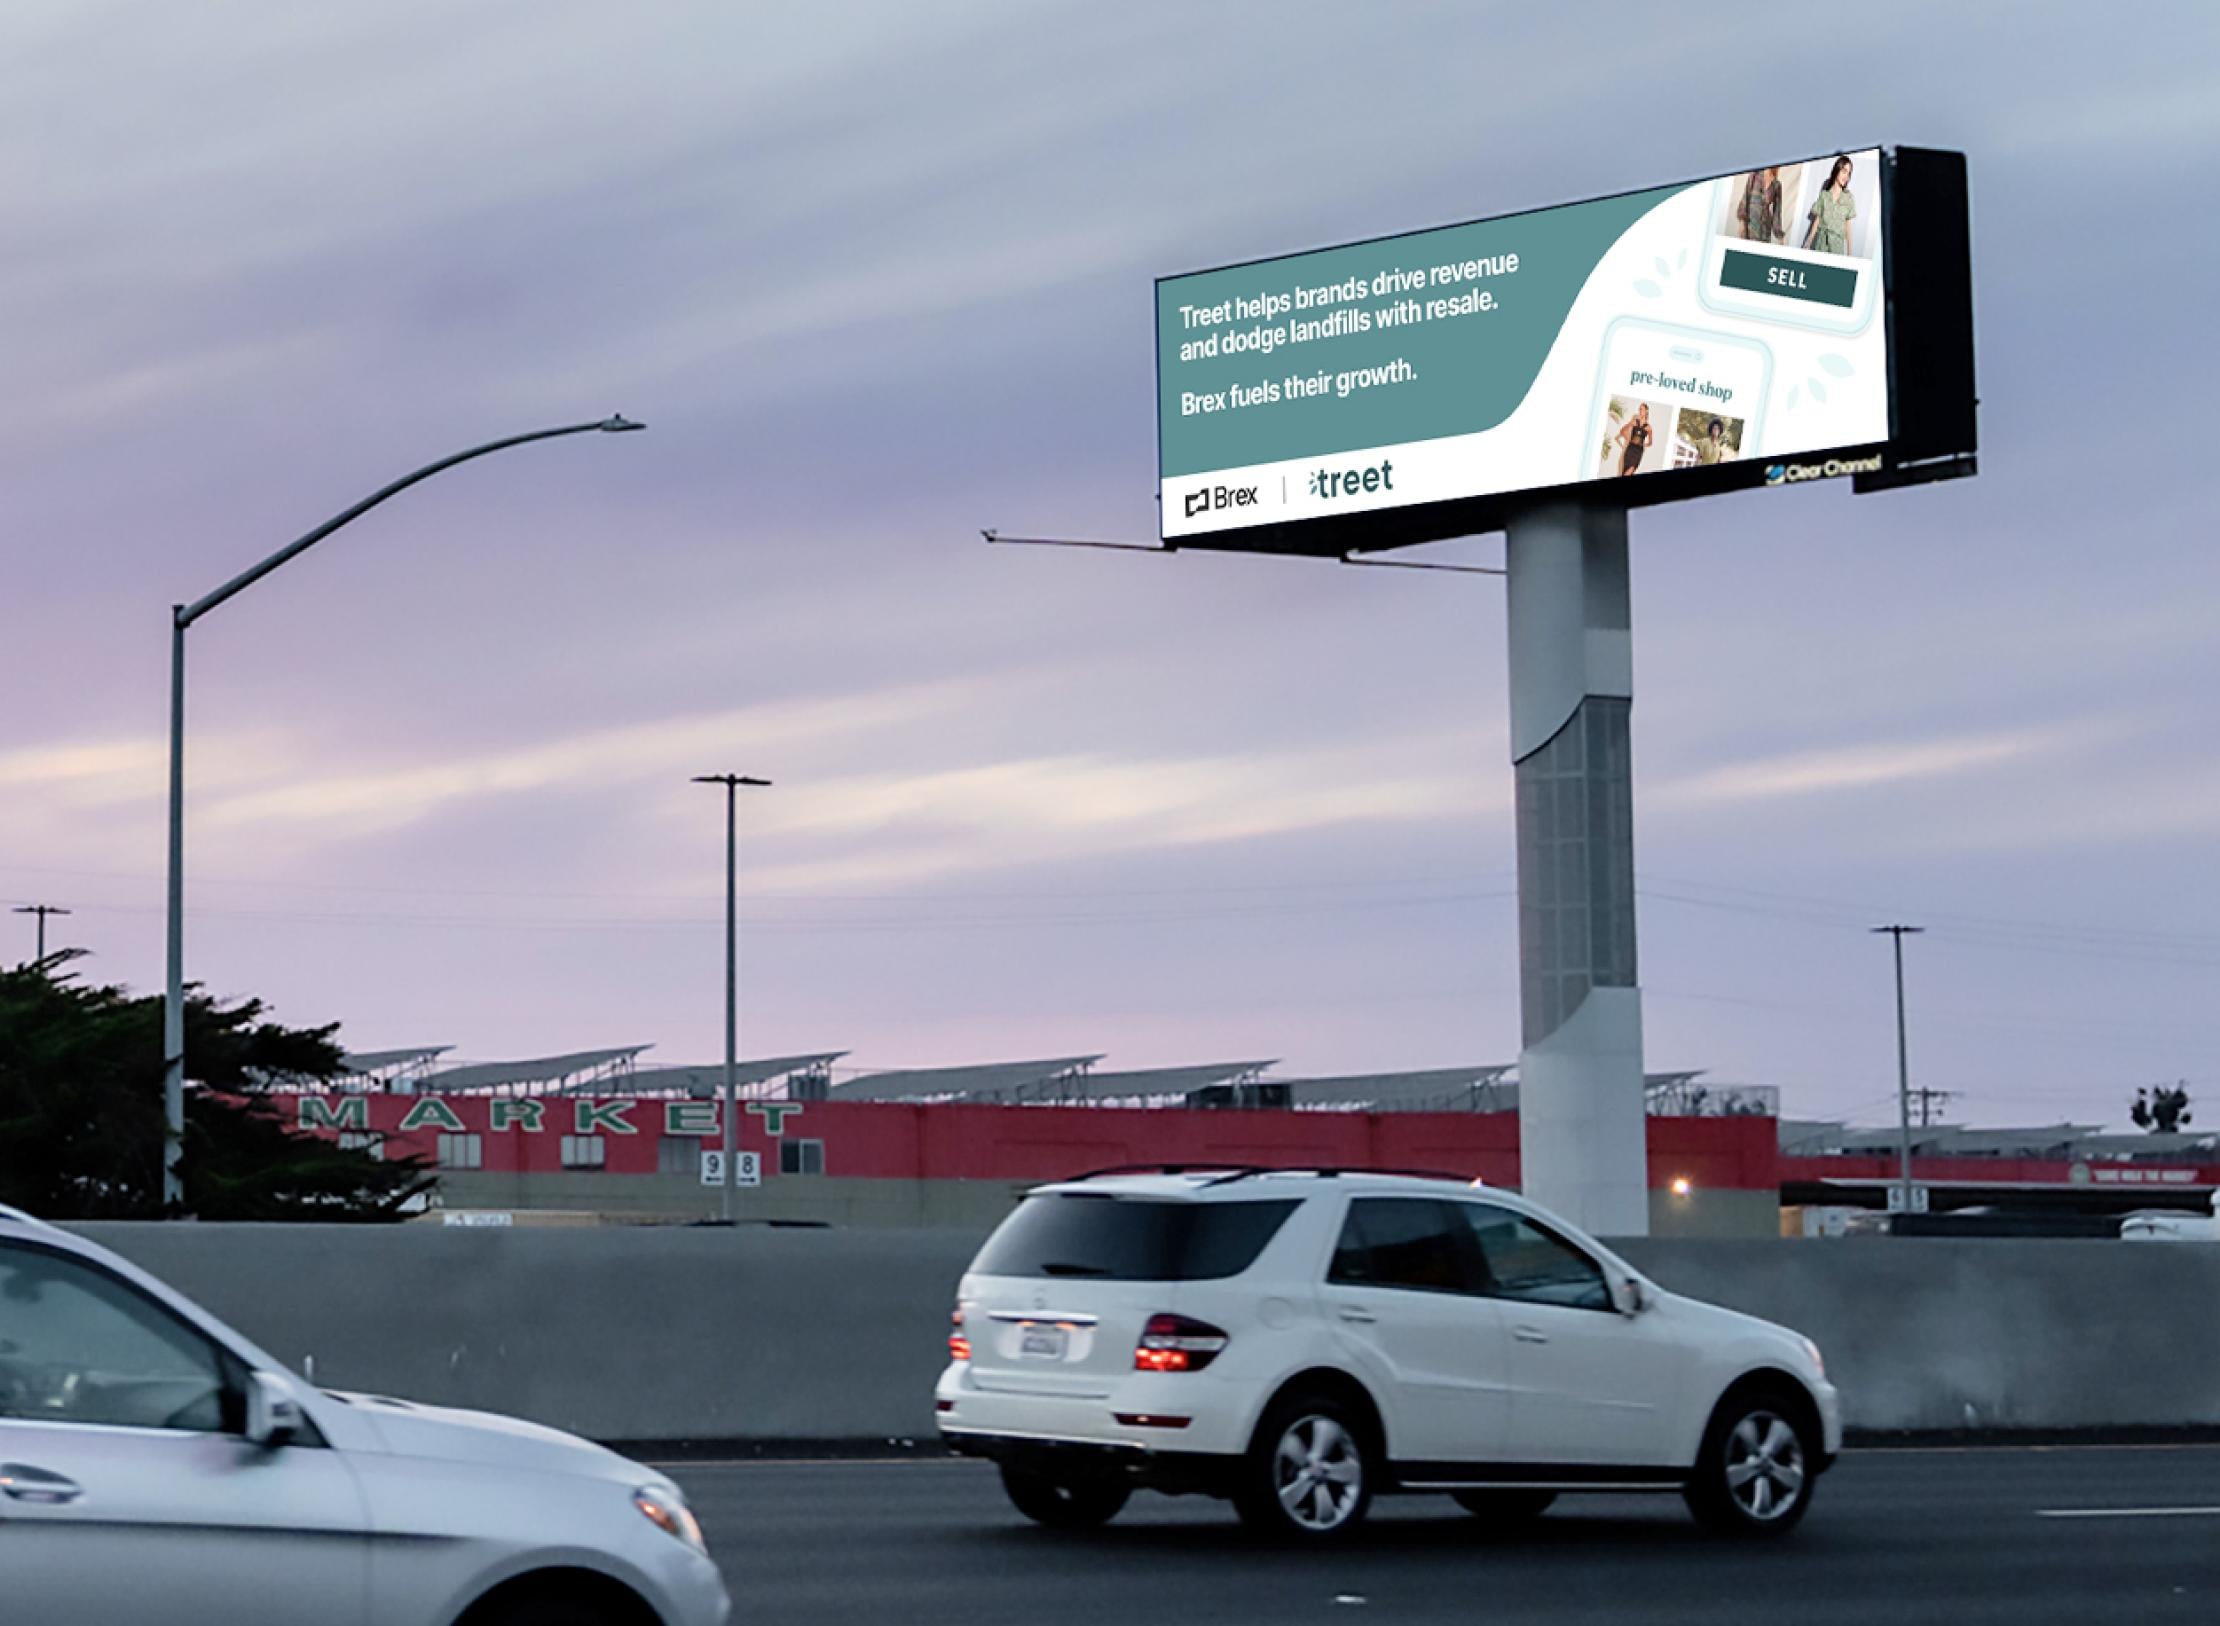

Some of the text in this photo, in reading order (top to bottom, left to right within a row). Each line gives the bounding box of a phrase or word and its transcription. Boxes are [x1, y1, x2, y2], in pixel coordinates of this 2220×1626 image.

[1180, 253, 1519, 328] Treet helps brands drive revenue
[1766, 266, 1807, 290] SELL
[1180, 287, 1498, 361] and dodge landfills with resale.
[1181, 357, 1418, 416] Brex fuels their growth.
[1630, 369, 1733, 403] pre-loved shop
[1213, 485, 1258, 510] Brex
[1315, 459, 1393, 499] treet
[298, 1096, 803, 1136] MARKET
[707, 1154, 720, 1174] 9
[742, 1154, 754, 1175] 8
